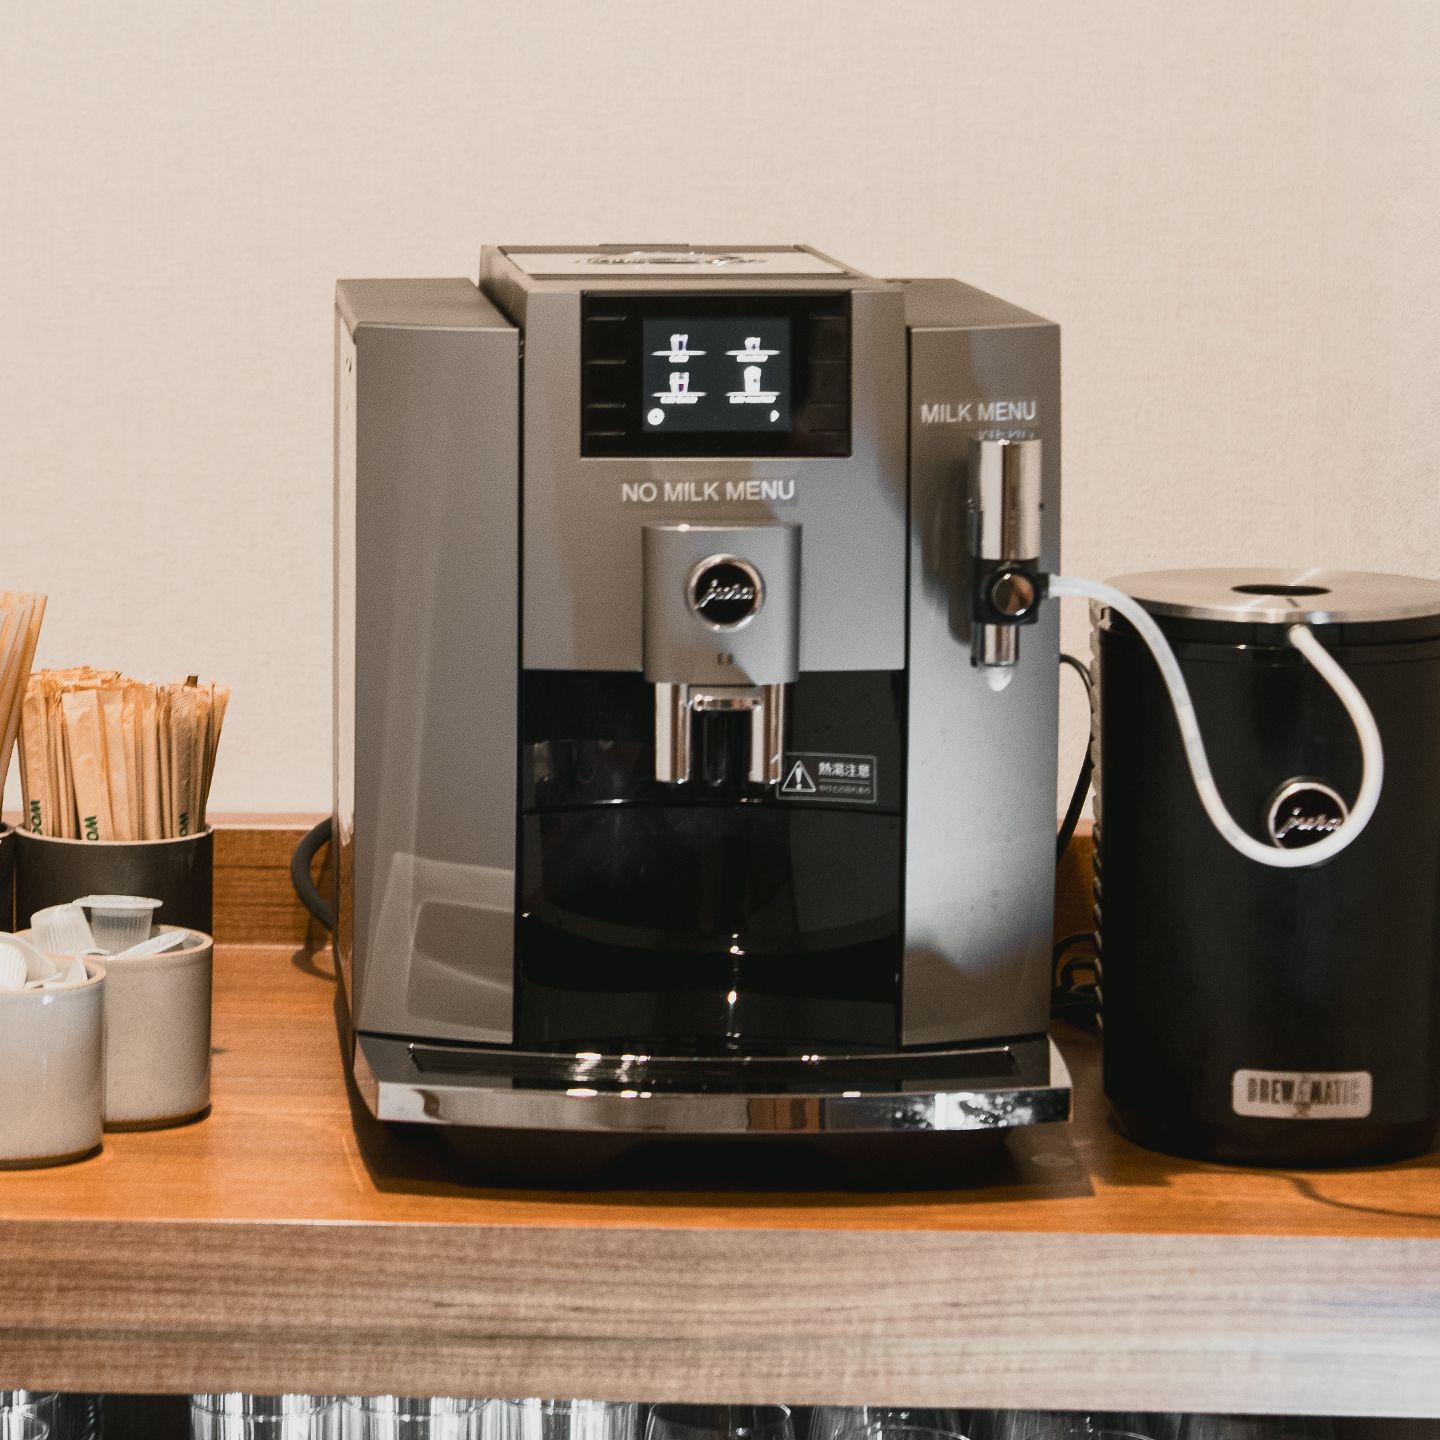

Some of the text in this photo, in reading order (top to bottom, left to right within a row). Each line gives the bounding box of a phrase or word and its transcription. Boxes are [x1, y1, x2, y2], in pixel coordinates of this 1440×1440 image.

[921, 400, 1037, 423] MILK MENU
[621, 479, 795, 502] NO MILK MENU
